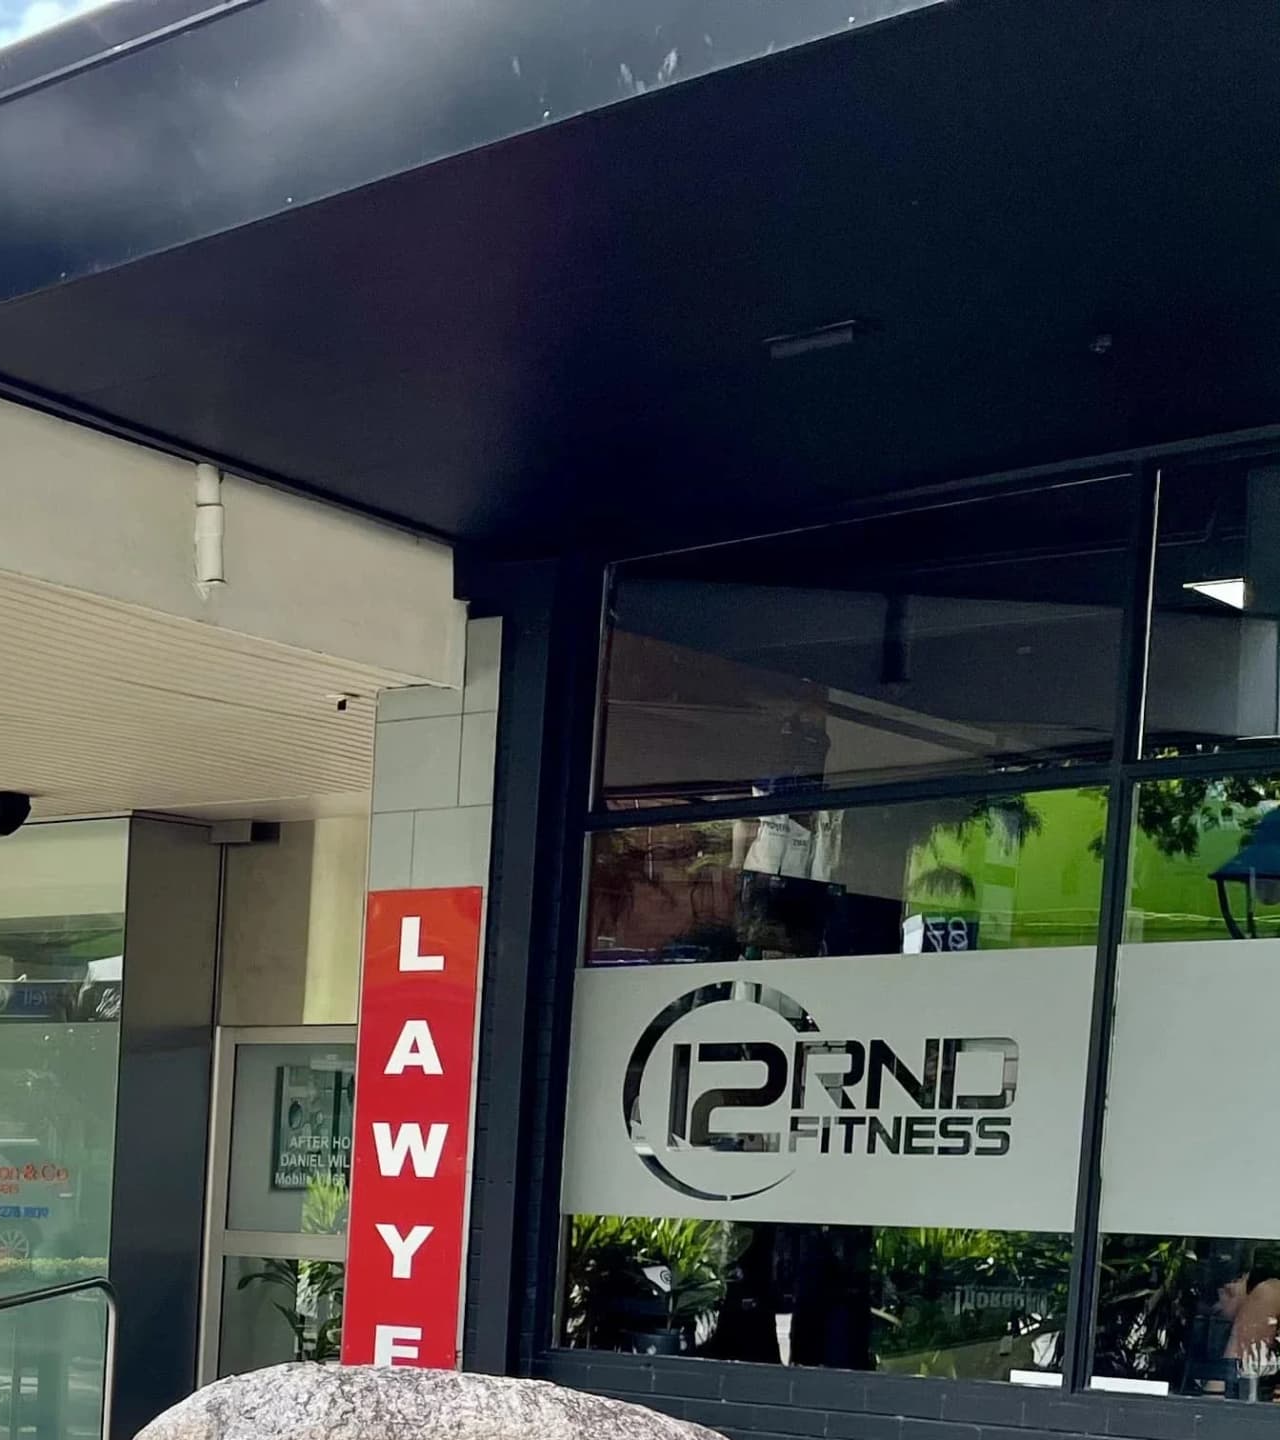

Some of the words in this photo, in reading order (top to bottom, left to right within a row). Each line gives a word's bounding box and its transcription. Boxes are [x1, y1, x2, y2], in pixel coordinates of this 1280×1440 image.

[289, 1136, 329, 1149] AFTER
[788, 1115, 1012, 1157] FITNESS
[280, 1154, 325, 1168] DANIEL
[23, 1163, 37, 1181] &
